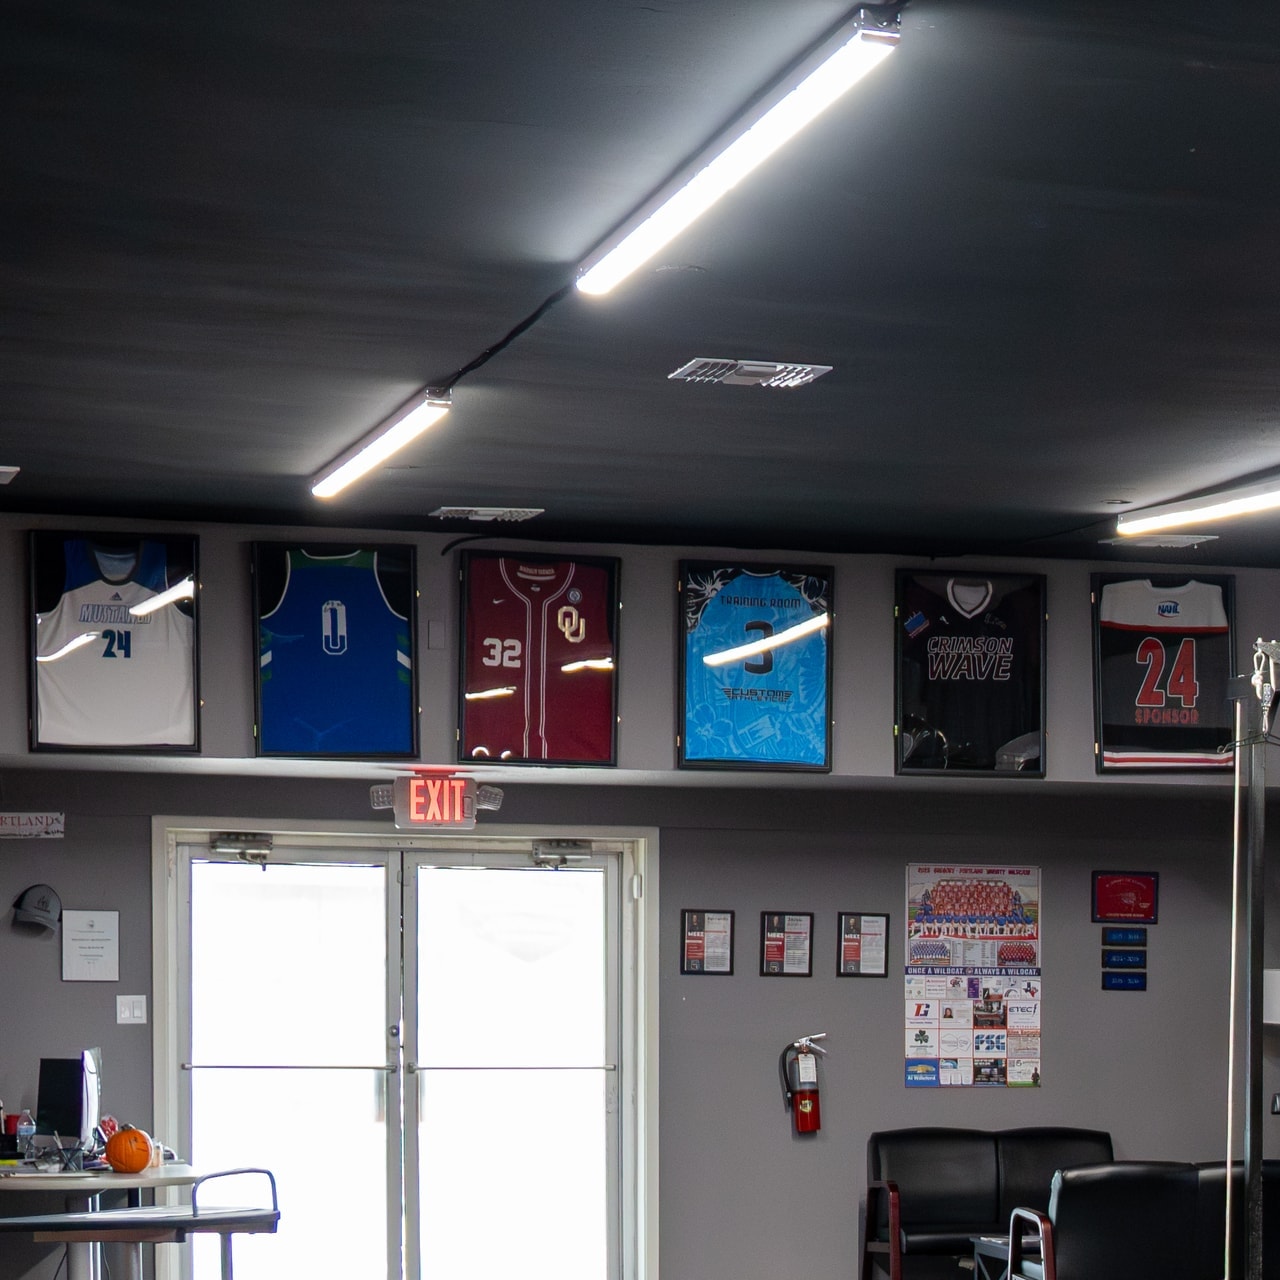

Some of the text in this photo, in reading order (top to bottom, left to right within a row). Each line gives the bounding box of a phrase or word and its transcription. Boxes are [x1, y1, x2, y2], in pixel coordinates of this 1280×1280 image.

[720, 595, 801, 609] TRAINING ROOM
[322, 600, 348, 655] 0
[558, 605, 586, 643] OU
[102, 628, 131, 659] 24
[482, 637, 522, 669] 32
[744, 620, 774, 675] 3
[927, 636, 1014, 654] CRIMSON
[927, 653, 1014, 681] WAVE
[1135, 636, 1199, 708] 24
[731, 688, 784, 697] CUSTOM
[1134, 707, 1200, 725] SPONSOR
[409, 779, 465, 821] EXIT
[927, 967, 933, 975] A
[974, 967, 1000, 975] ALWAYS
